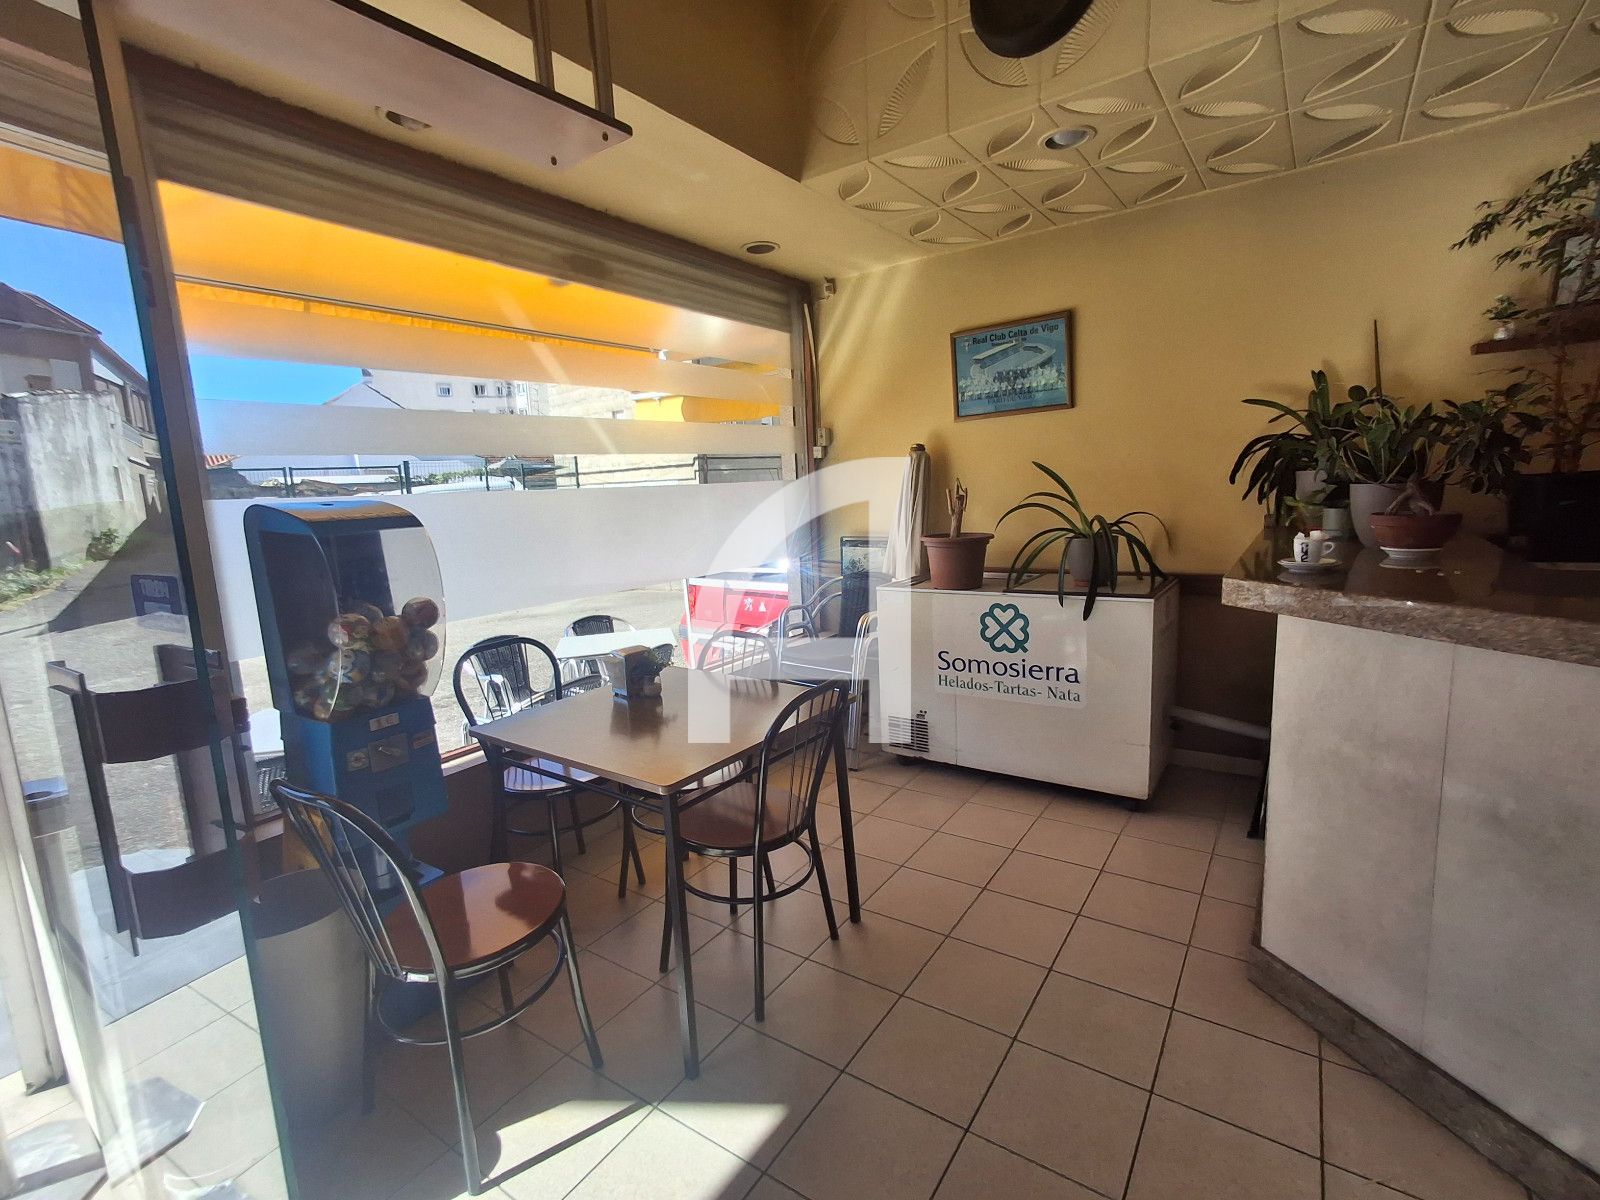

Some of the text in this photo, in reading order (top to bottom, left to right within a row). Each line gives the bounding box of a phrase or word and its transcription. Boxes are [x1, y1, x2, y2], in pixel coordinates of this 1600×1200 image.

[972, 335, 988, 345] Real
[989, 332, 1006, 342] Club
[1008, 328, 1028, 339] Celta
[1029, 325, 1039, 335] de
[1041, 323, 1059, 333] Vigo
[938, 651, 1080, 684] Somosierra
[1047, 686, 1080, 702] Nata
